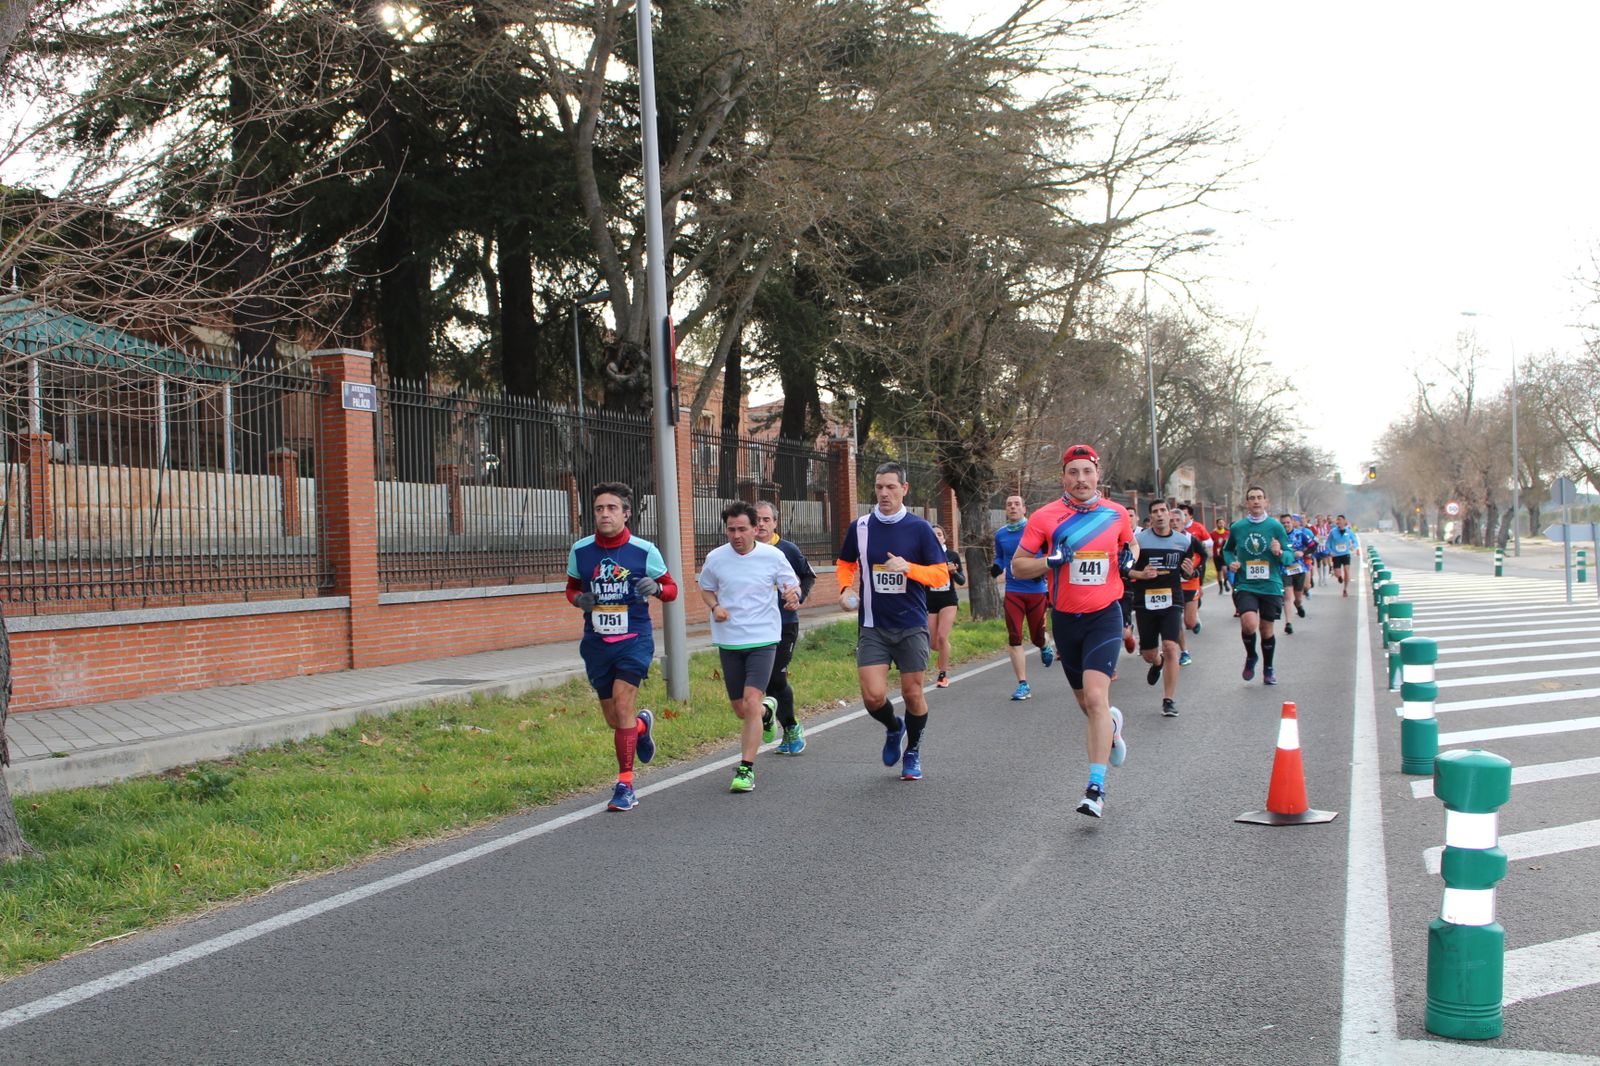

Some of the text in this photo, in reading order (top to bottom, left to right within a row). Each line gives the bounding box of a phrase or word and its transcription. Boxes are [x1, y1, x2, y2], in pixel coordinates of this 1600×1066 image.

[352, 397, 371, 408] PALACIO
[1079, 561, 1102, 575] 441
[1250, 566, 1265, 574] 386
[876, 574, 903, 585] 1650
[590, 580, 628, 594] LA TAPIA
[1150, 594, 1167, 604] 439
[598, 614, 622, 626] 1751
